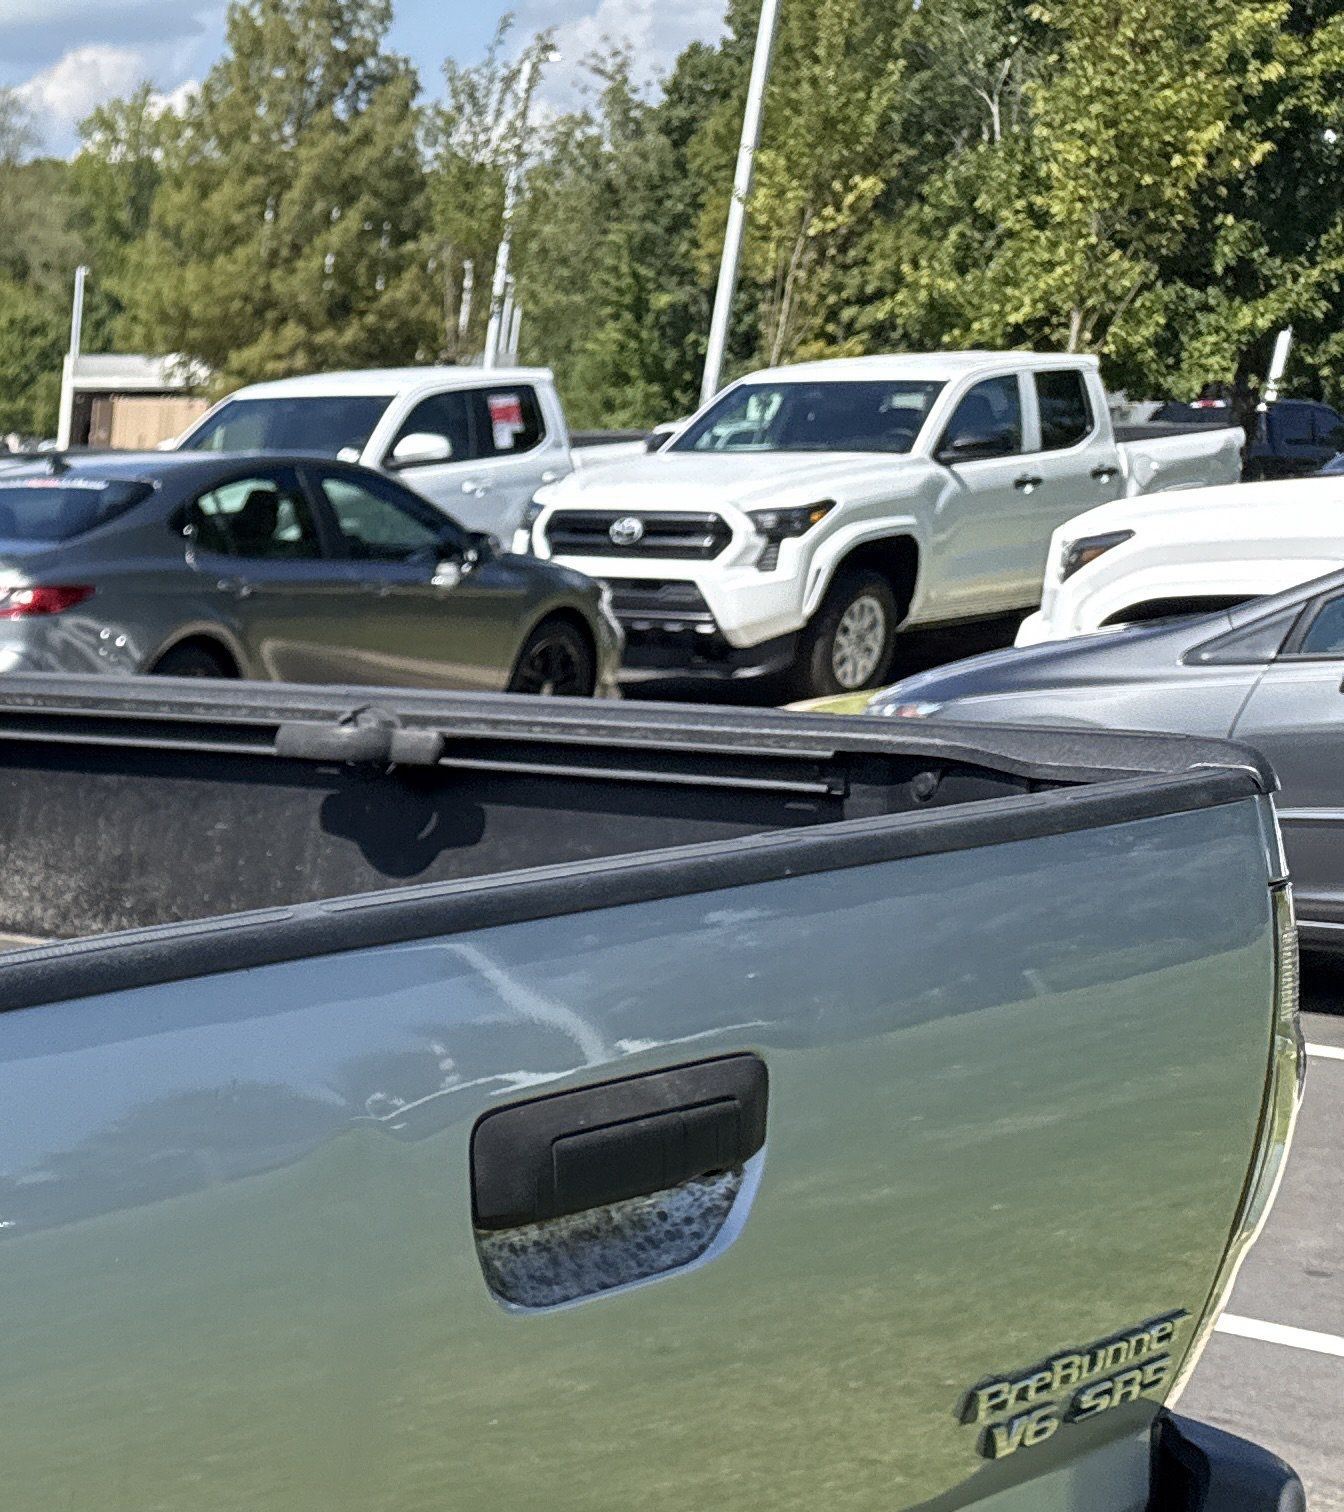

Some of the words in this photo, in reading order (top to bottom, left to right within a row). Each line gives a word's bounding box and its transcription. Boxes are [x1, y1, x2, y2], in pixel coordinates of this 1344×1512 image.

[960, 1308, 1192, 1424] PreRunner
[980, 1402, 1060, 1459] V6
[1063, 1352, 1172, 1423] SR5
